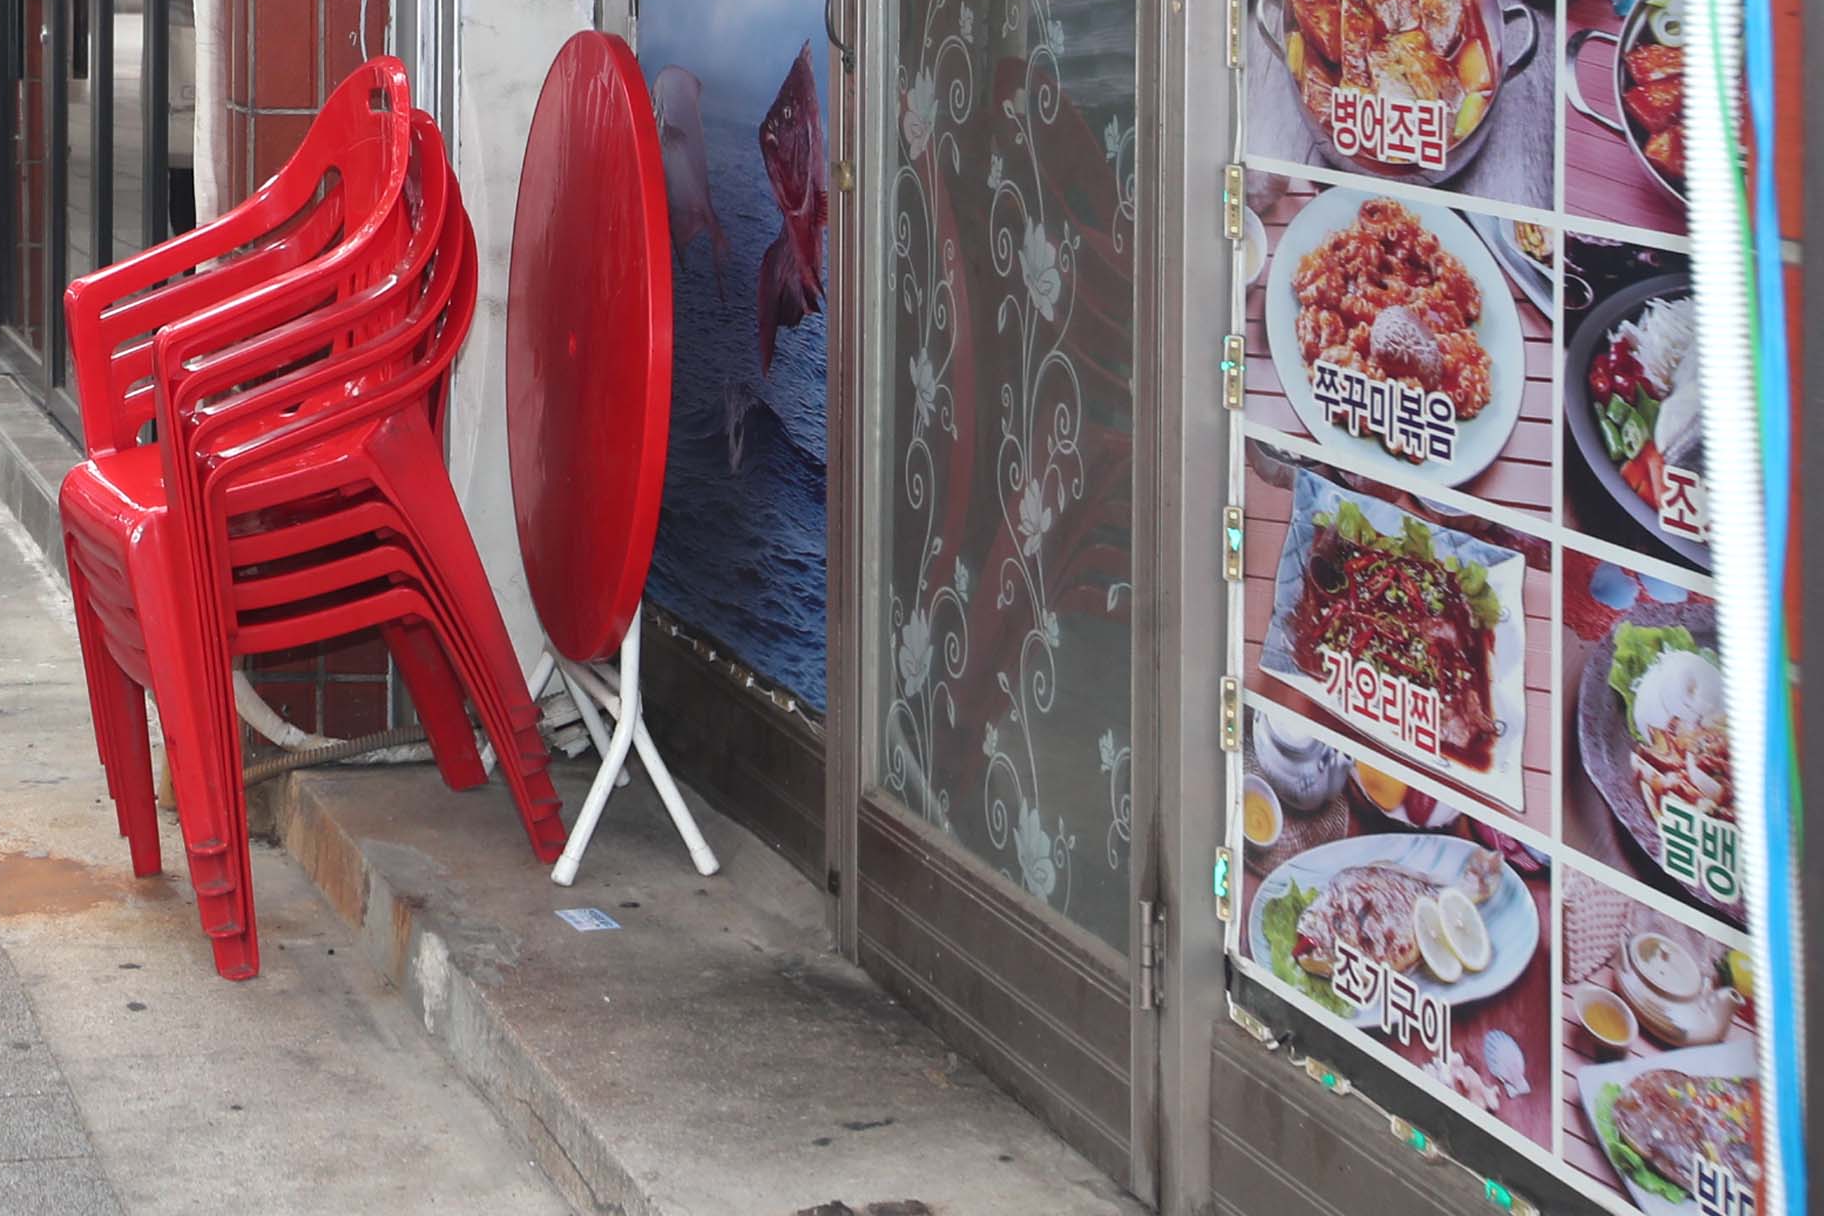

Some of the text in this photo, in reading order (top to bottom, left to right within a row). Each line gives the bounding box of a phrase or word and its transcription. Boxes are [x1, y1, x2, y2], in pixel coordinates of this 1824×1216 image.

[1331, 88, 1447, 168] 병어조림
[1314, 365, 1456, 460] 쭈꾸미볶음
[1326, 651, 1441, 756] 가오리찜
[1663, 803, 1738, 896] 골뱅
[1333, 945, 1453, 1064] 조기구이
